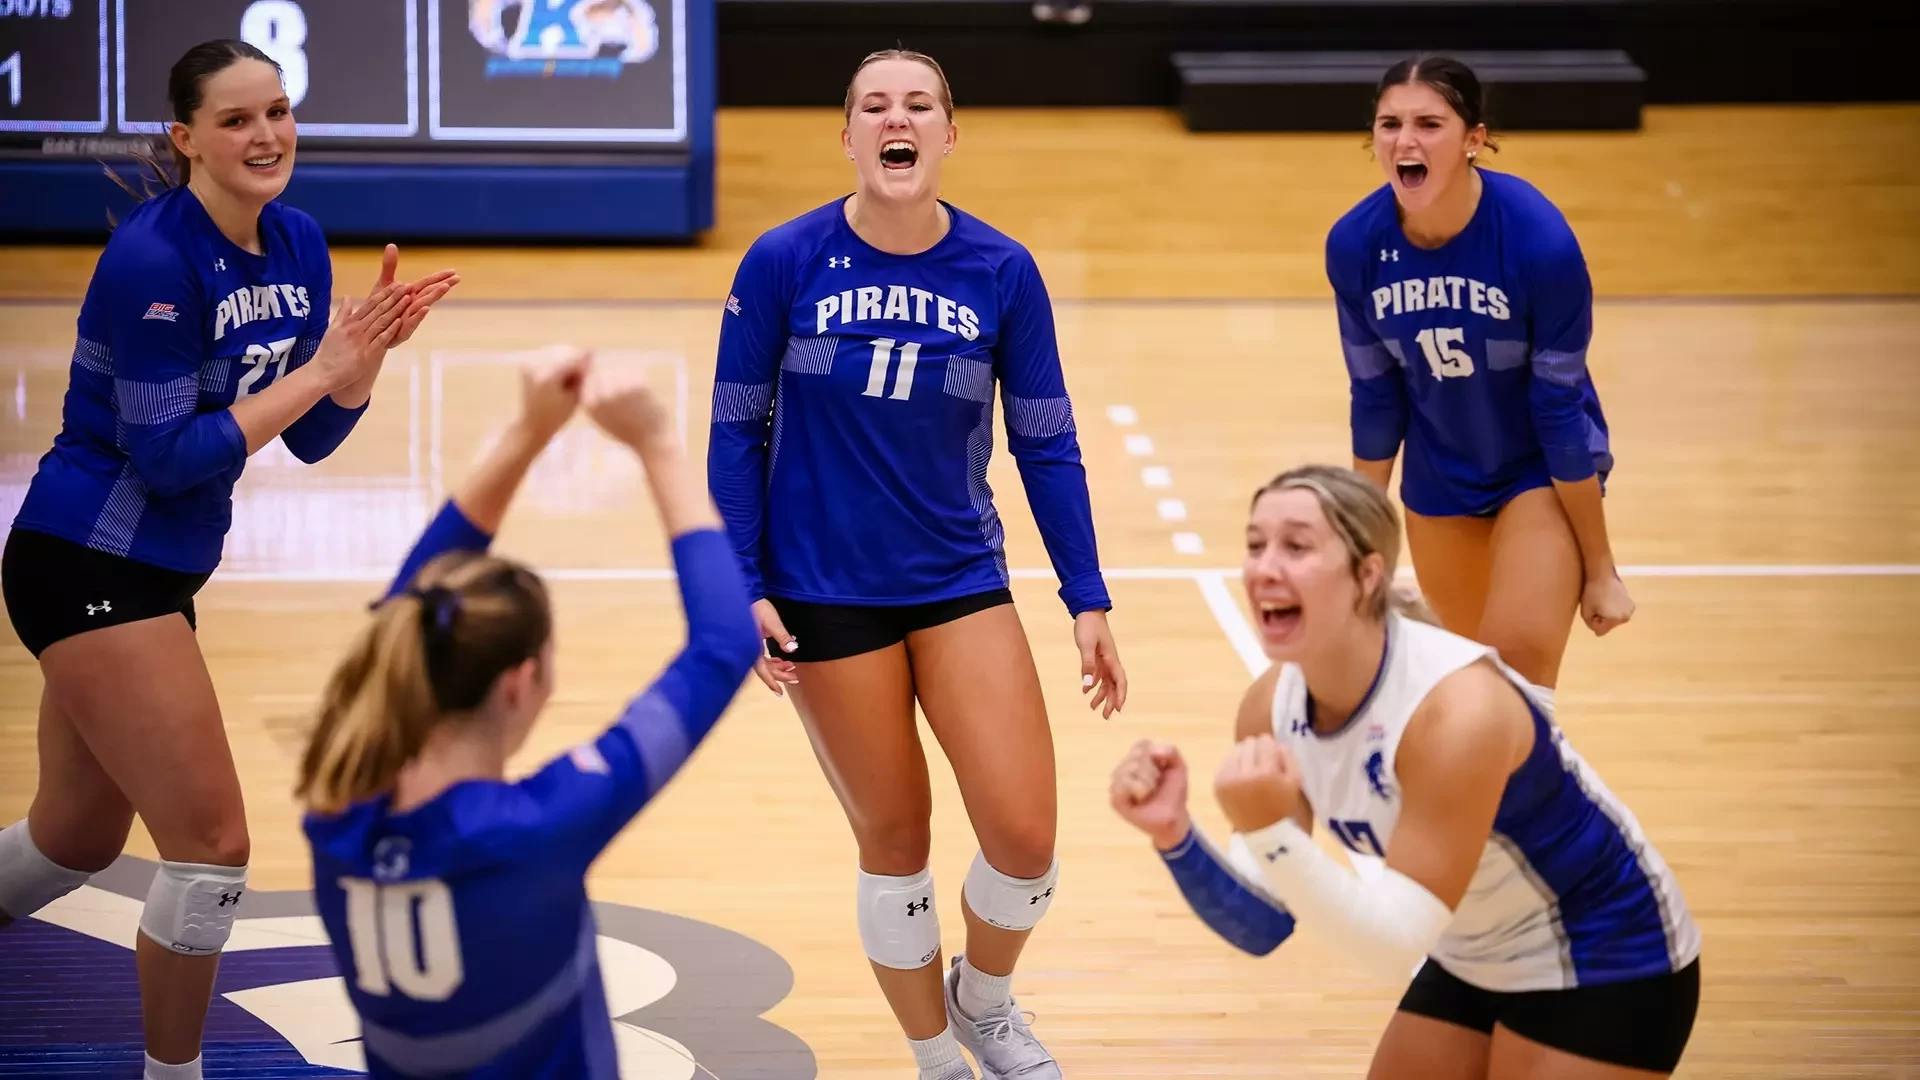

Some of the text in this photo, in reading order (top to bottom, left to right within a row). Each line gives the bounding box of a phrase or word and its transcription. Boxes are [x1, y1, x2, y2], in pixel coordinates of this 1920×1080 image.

[240, 0, 308, 108] 8
[214, 284, 311, 341] PIRATES
[816, 285, 979, 341] PIRATES
[1372, 276, 1510, 320] PIRATES
[234, 337, 297, 403] 27
[861, 338, 921, 400] 11
[1415, 328, 1474, 381] 15
[338, 877, 463, 1001] 10
